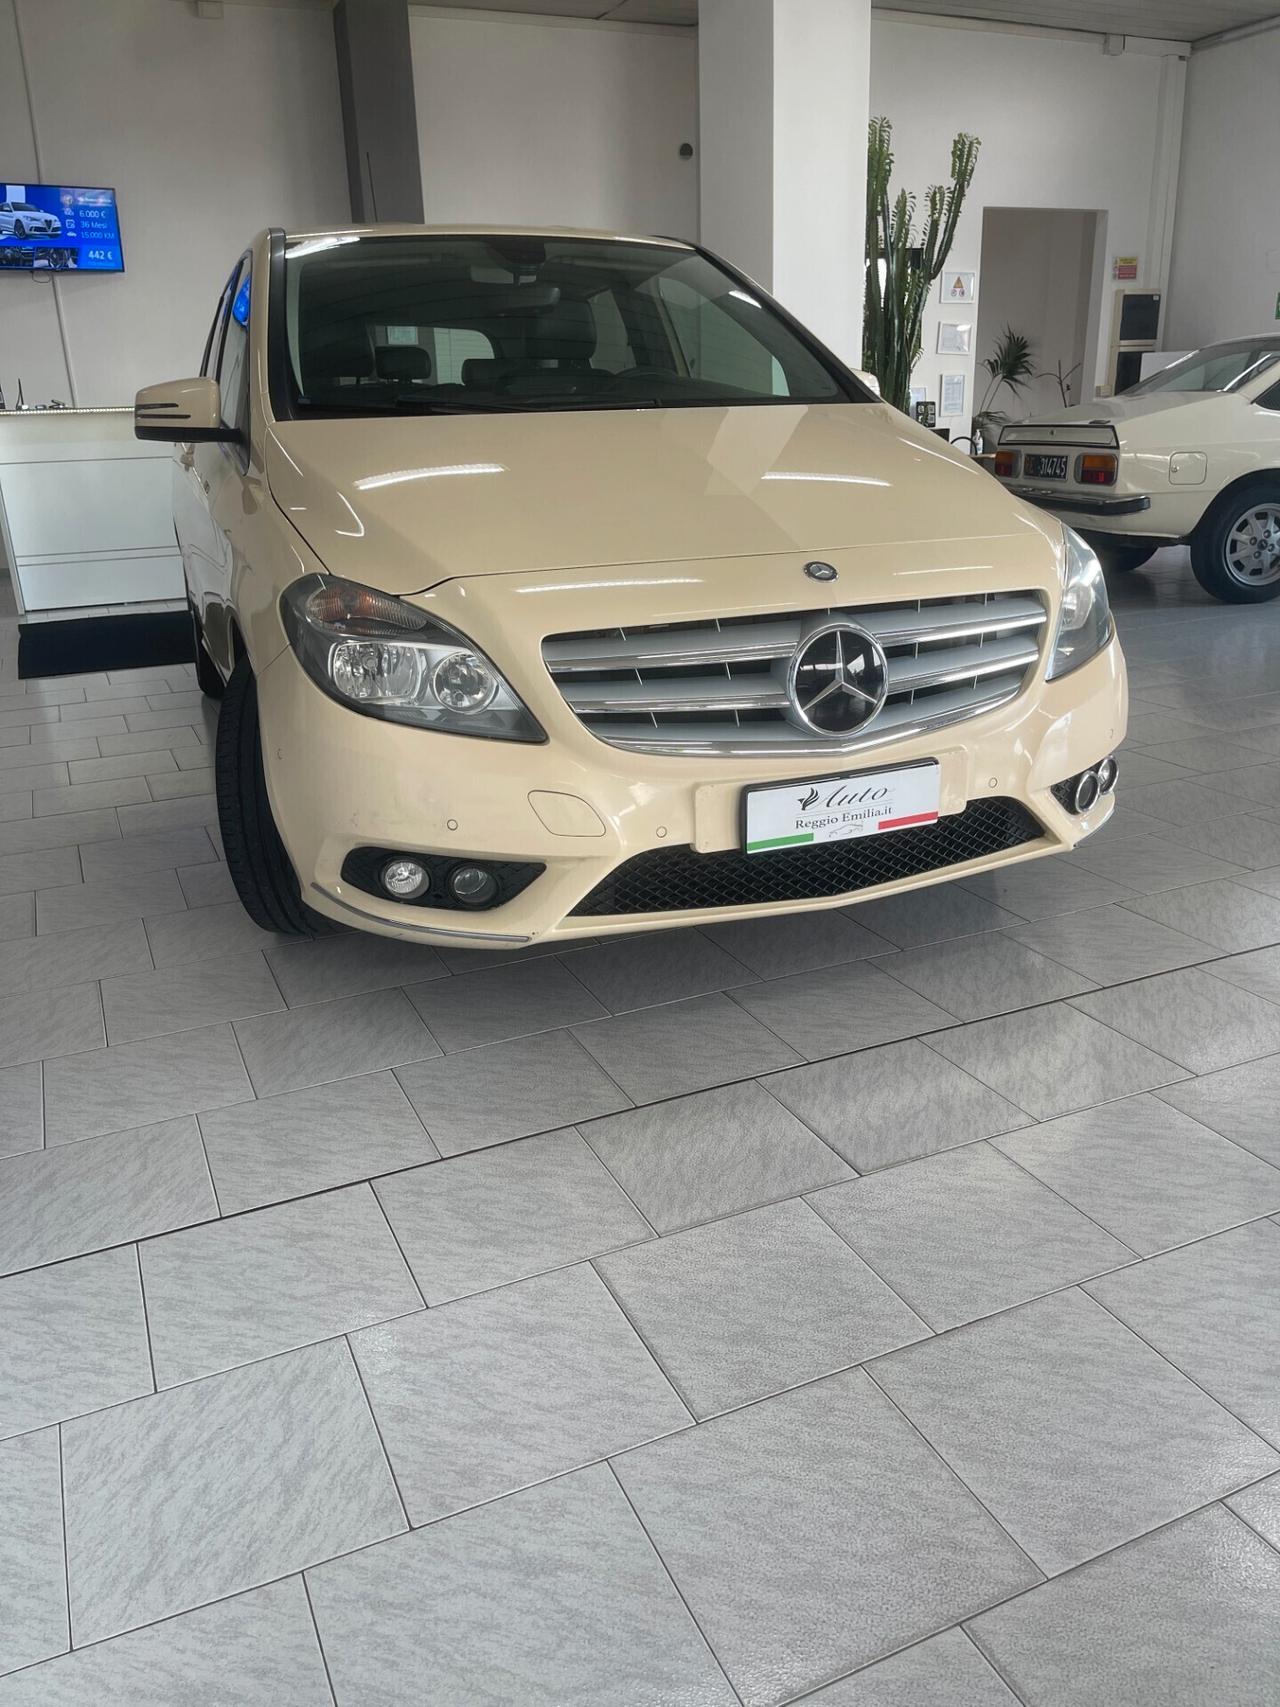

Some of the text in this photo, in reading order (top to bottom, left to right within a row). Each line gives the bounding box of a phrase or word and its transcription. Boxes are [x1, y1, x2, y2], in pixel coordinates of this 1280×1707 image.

[79, 210, 99, 218] 6.000
[80, 221, 107, 229] 36 Mesi
[81, 231, 102, 239] 15.000
[88, 250, 113, 260] 442 €
[1040, 457, 1066, 477] 314745
[806, 784, 891, 809] Auto
[795, 806, 893, 830] Reggio Emilia.it
